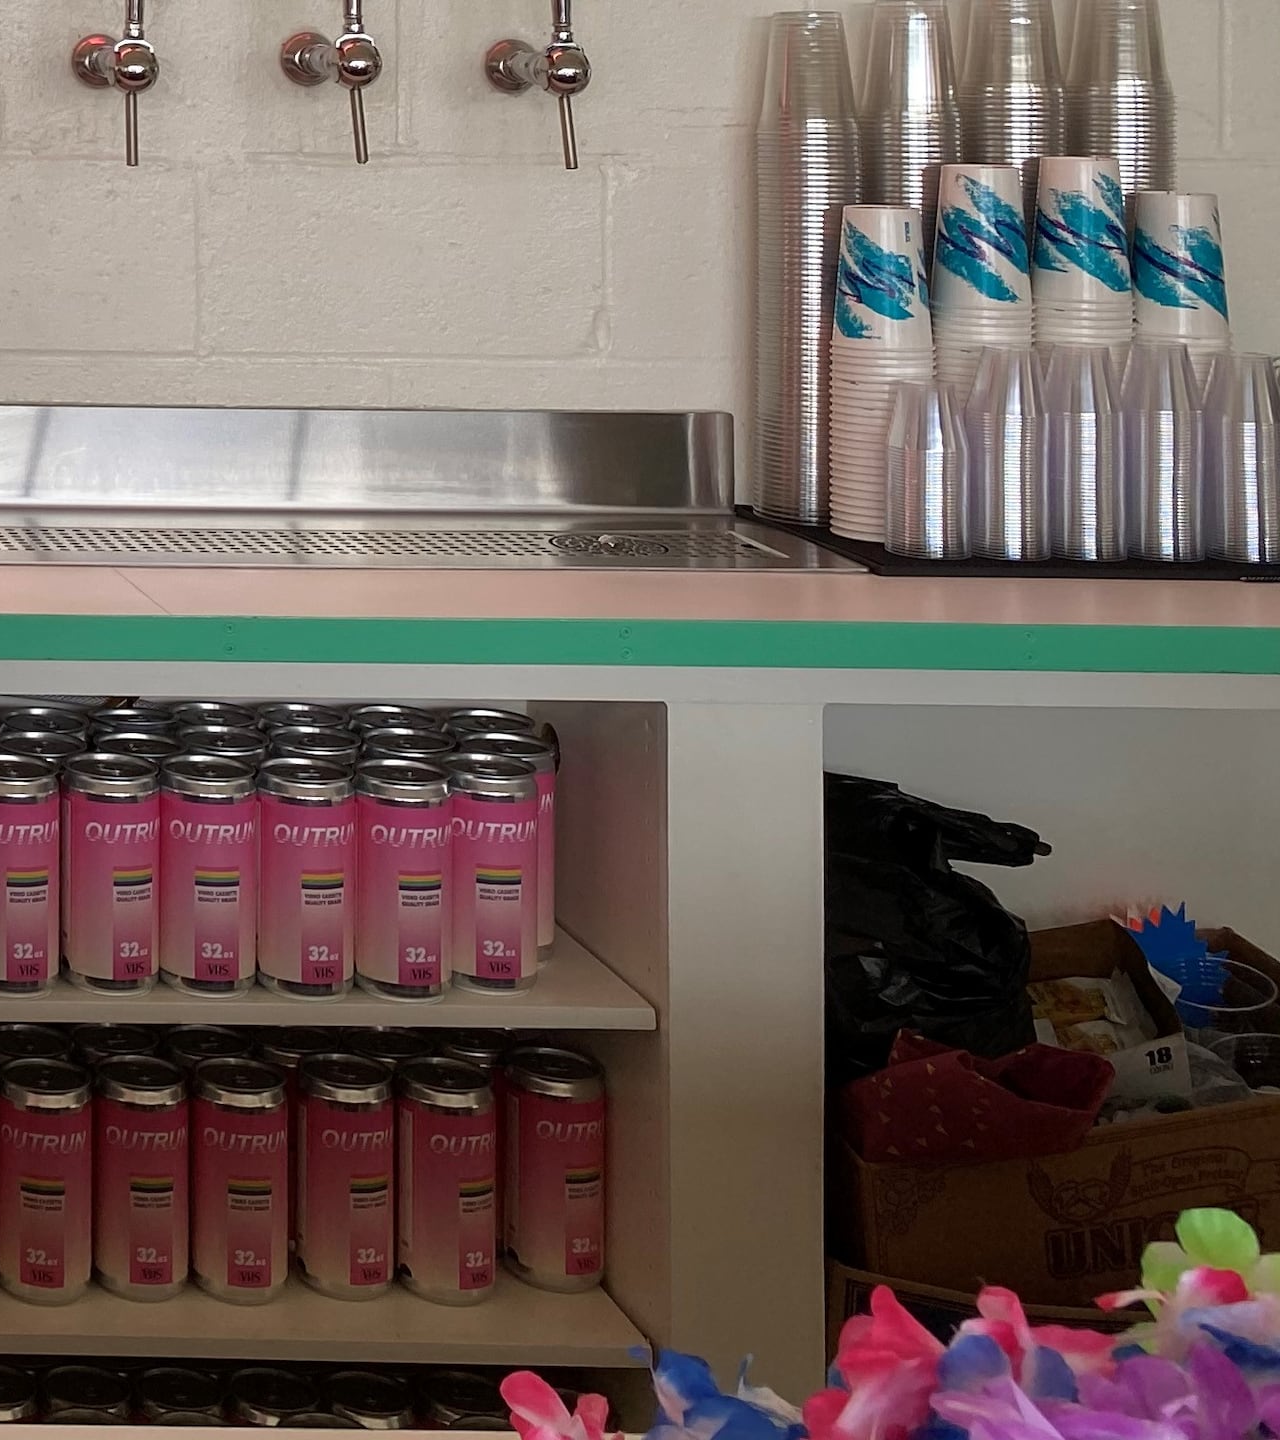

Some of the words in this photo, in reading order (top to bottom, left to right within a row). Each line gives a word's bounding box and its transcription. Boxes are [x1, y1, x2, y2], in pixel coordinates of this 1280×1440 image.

[85, 817, 160, 845] OUTRU
[273, 822, 354, 848] OUTRU
[13, 943, 34, 960] 32
[120, 941, 139, 958] 32
[201, 942, 223, 959] 32
[308, 945, 329, 962] 32
[405, 946, 426, 963] 32
[482, 940, 505, 957] 32
[18, 963, 40, 977] VHS
[125, 961, 145, 975] VHS
[207, 963, 230, 976] VHS
[313, 966, 335, 978] VHS
[411, 967, 433, 980] VHS
[489, 961, 511, 973] VHS
[1144, 1046, 1172, 1066] 18
[572, 1237, 590, 1254] 32
[26, 1247, 46, 1265] 32
[136, 1247, 157, 1263] 32
[234, 1249, 255, 1266] 32
[357, 1247, 376, 1264] 32
[465, 1251, 484, 1268] 32
